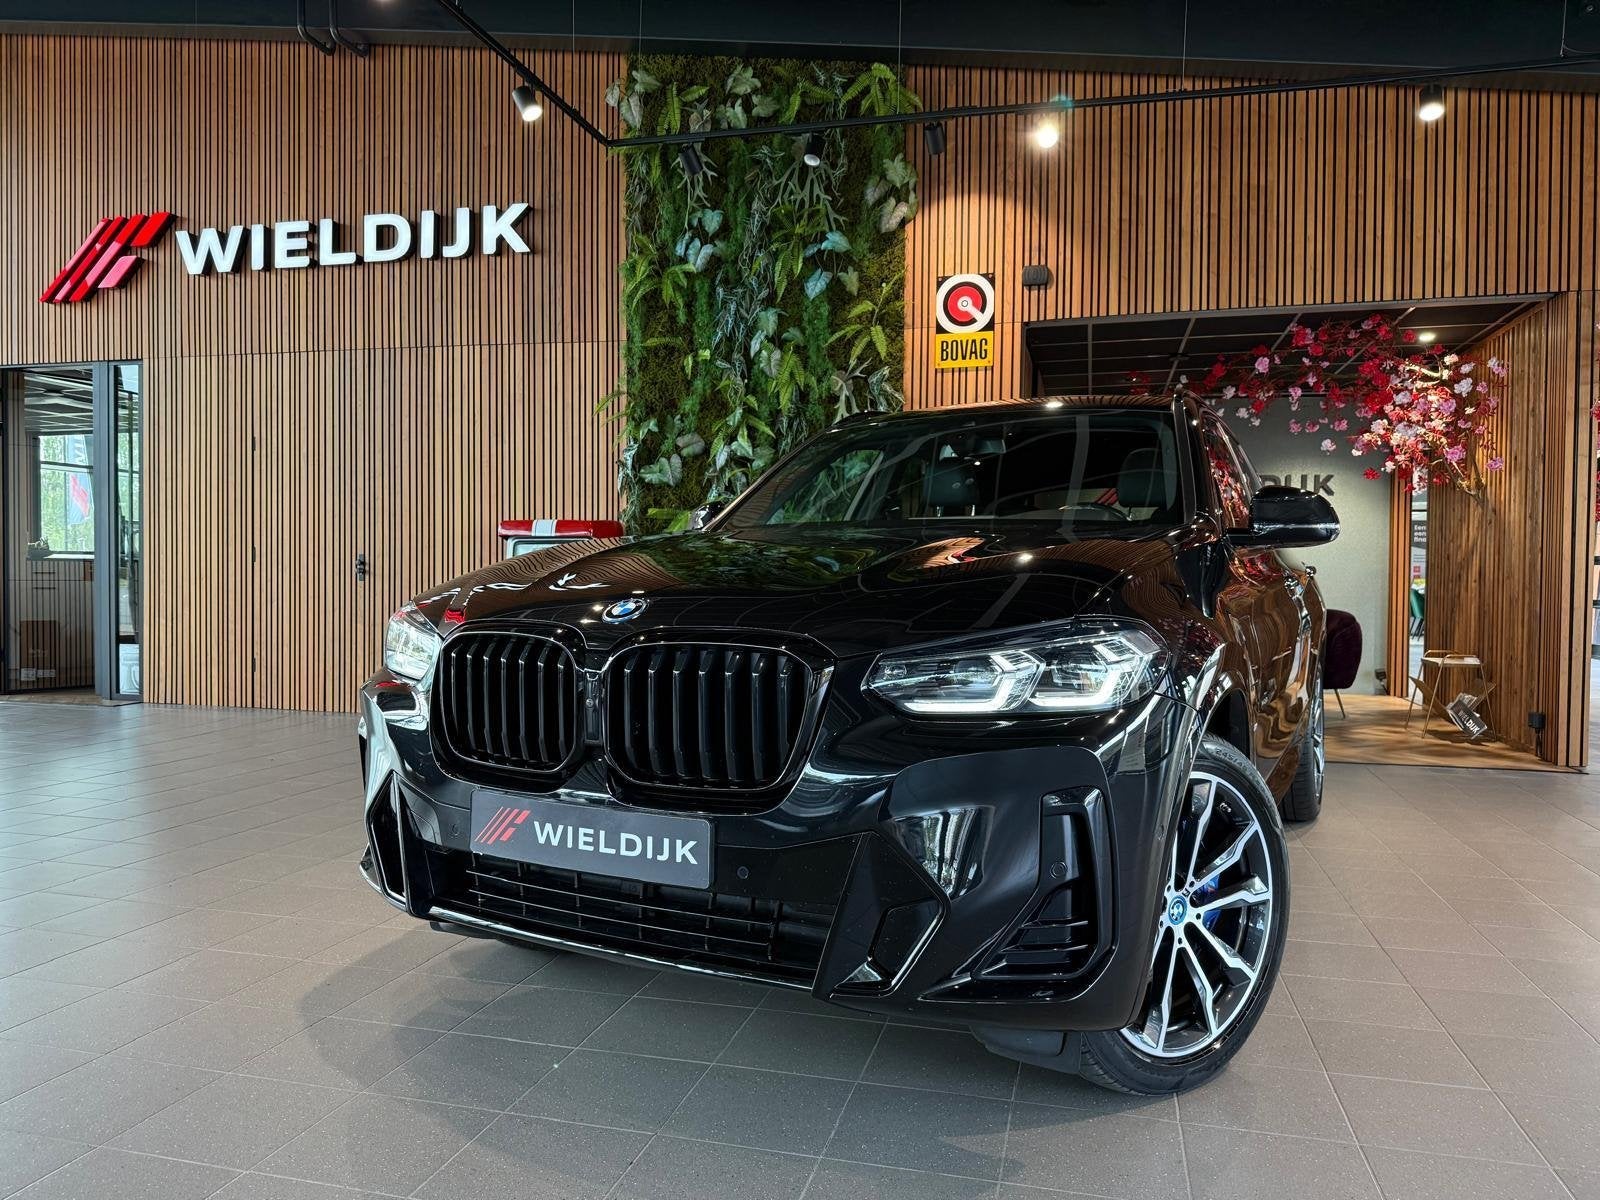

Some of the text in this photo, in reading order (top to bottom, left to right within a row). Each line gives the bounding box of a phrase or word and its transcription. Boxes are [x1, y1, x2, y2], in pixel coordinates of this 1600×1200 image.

[175, 202, 530, 275] WIELDIJK
[940, 337, 988, 362] BOVAG
[533, 820, 698, 865] WIELDIJK
